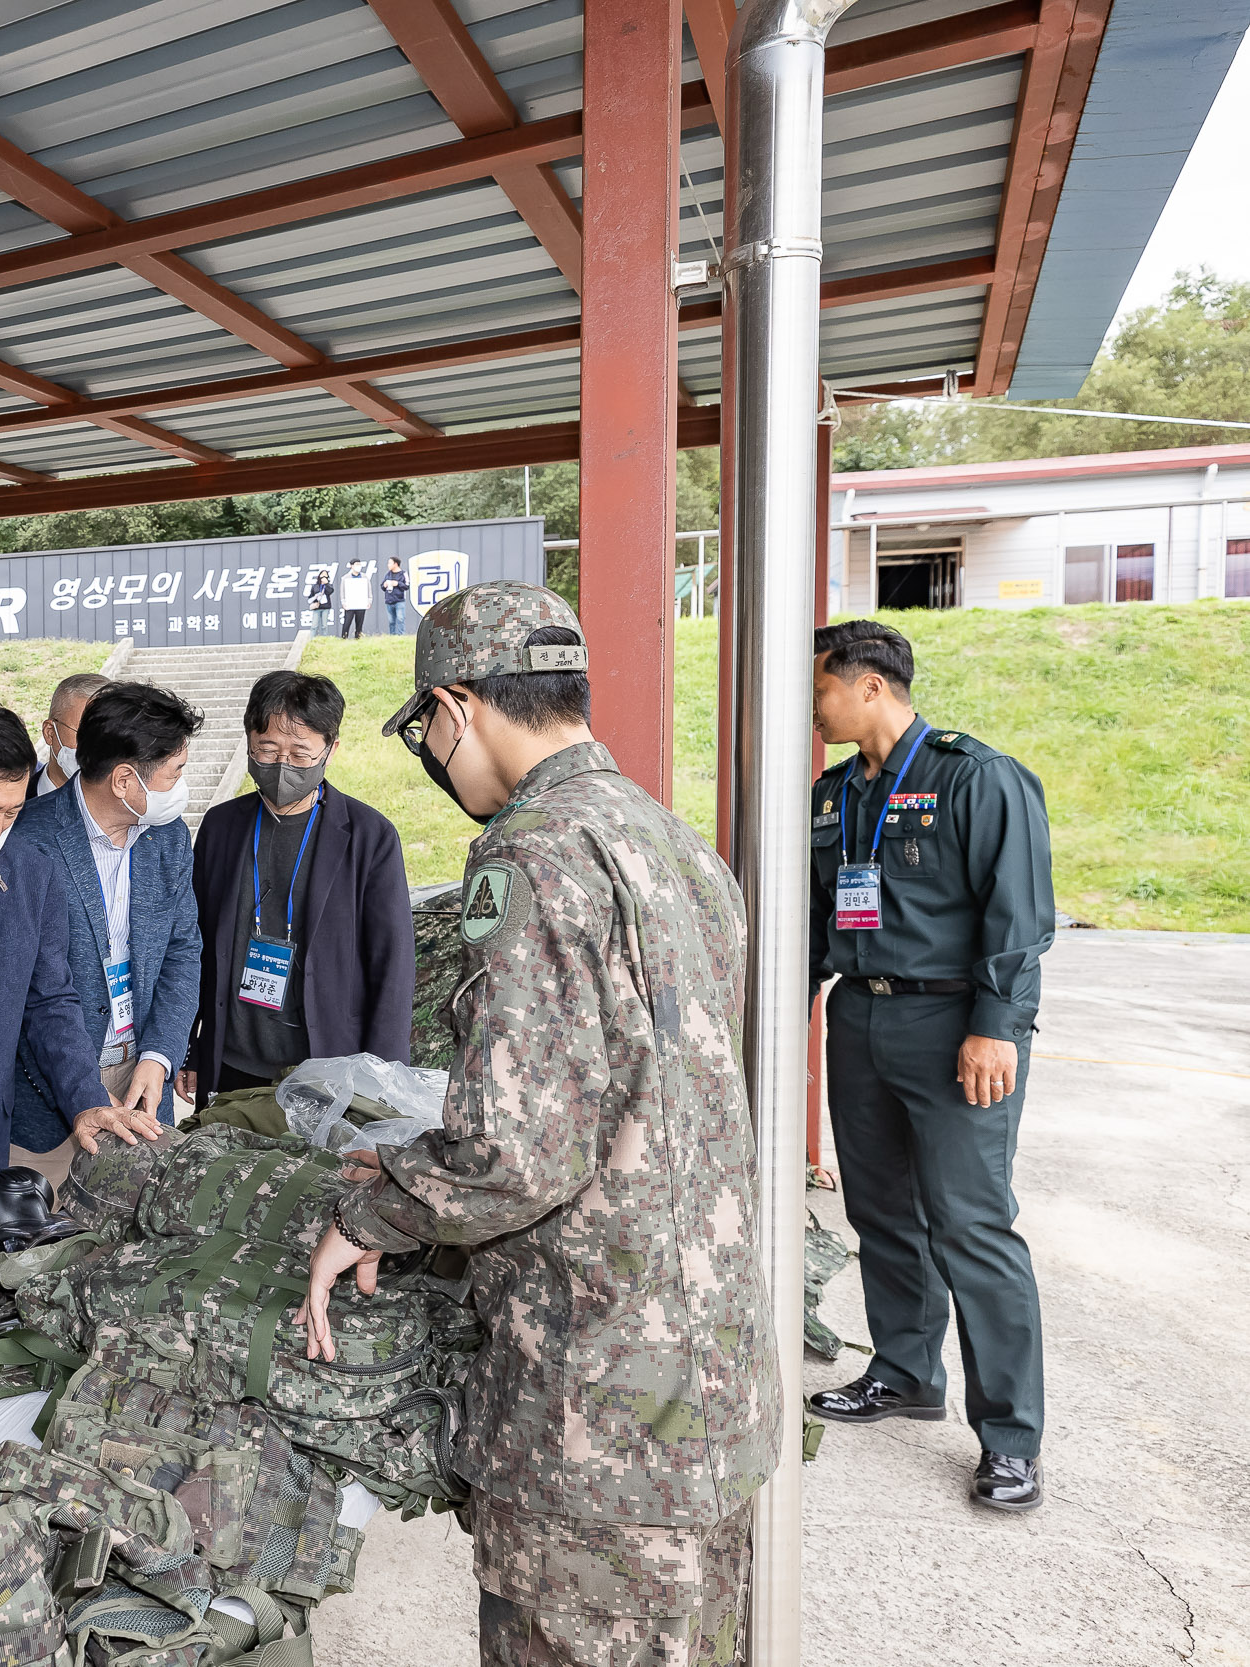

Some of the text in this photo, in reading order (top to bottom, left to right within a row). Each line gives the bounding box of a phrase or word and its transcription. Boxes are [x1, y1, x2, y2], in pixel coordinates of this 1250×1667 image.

[49, 571, 183, 611] 영상모의
[114, 618, 147, 636] 금곡
[167, 614, 220, 633] 과학화
[844, 896, 870, 906] 김민우
